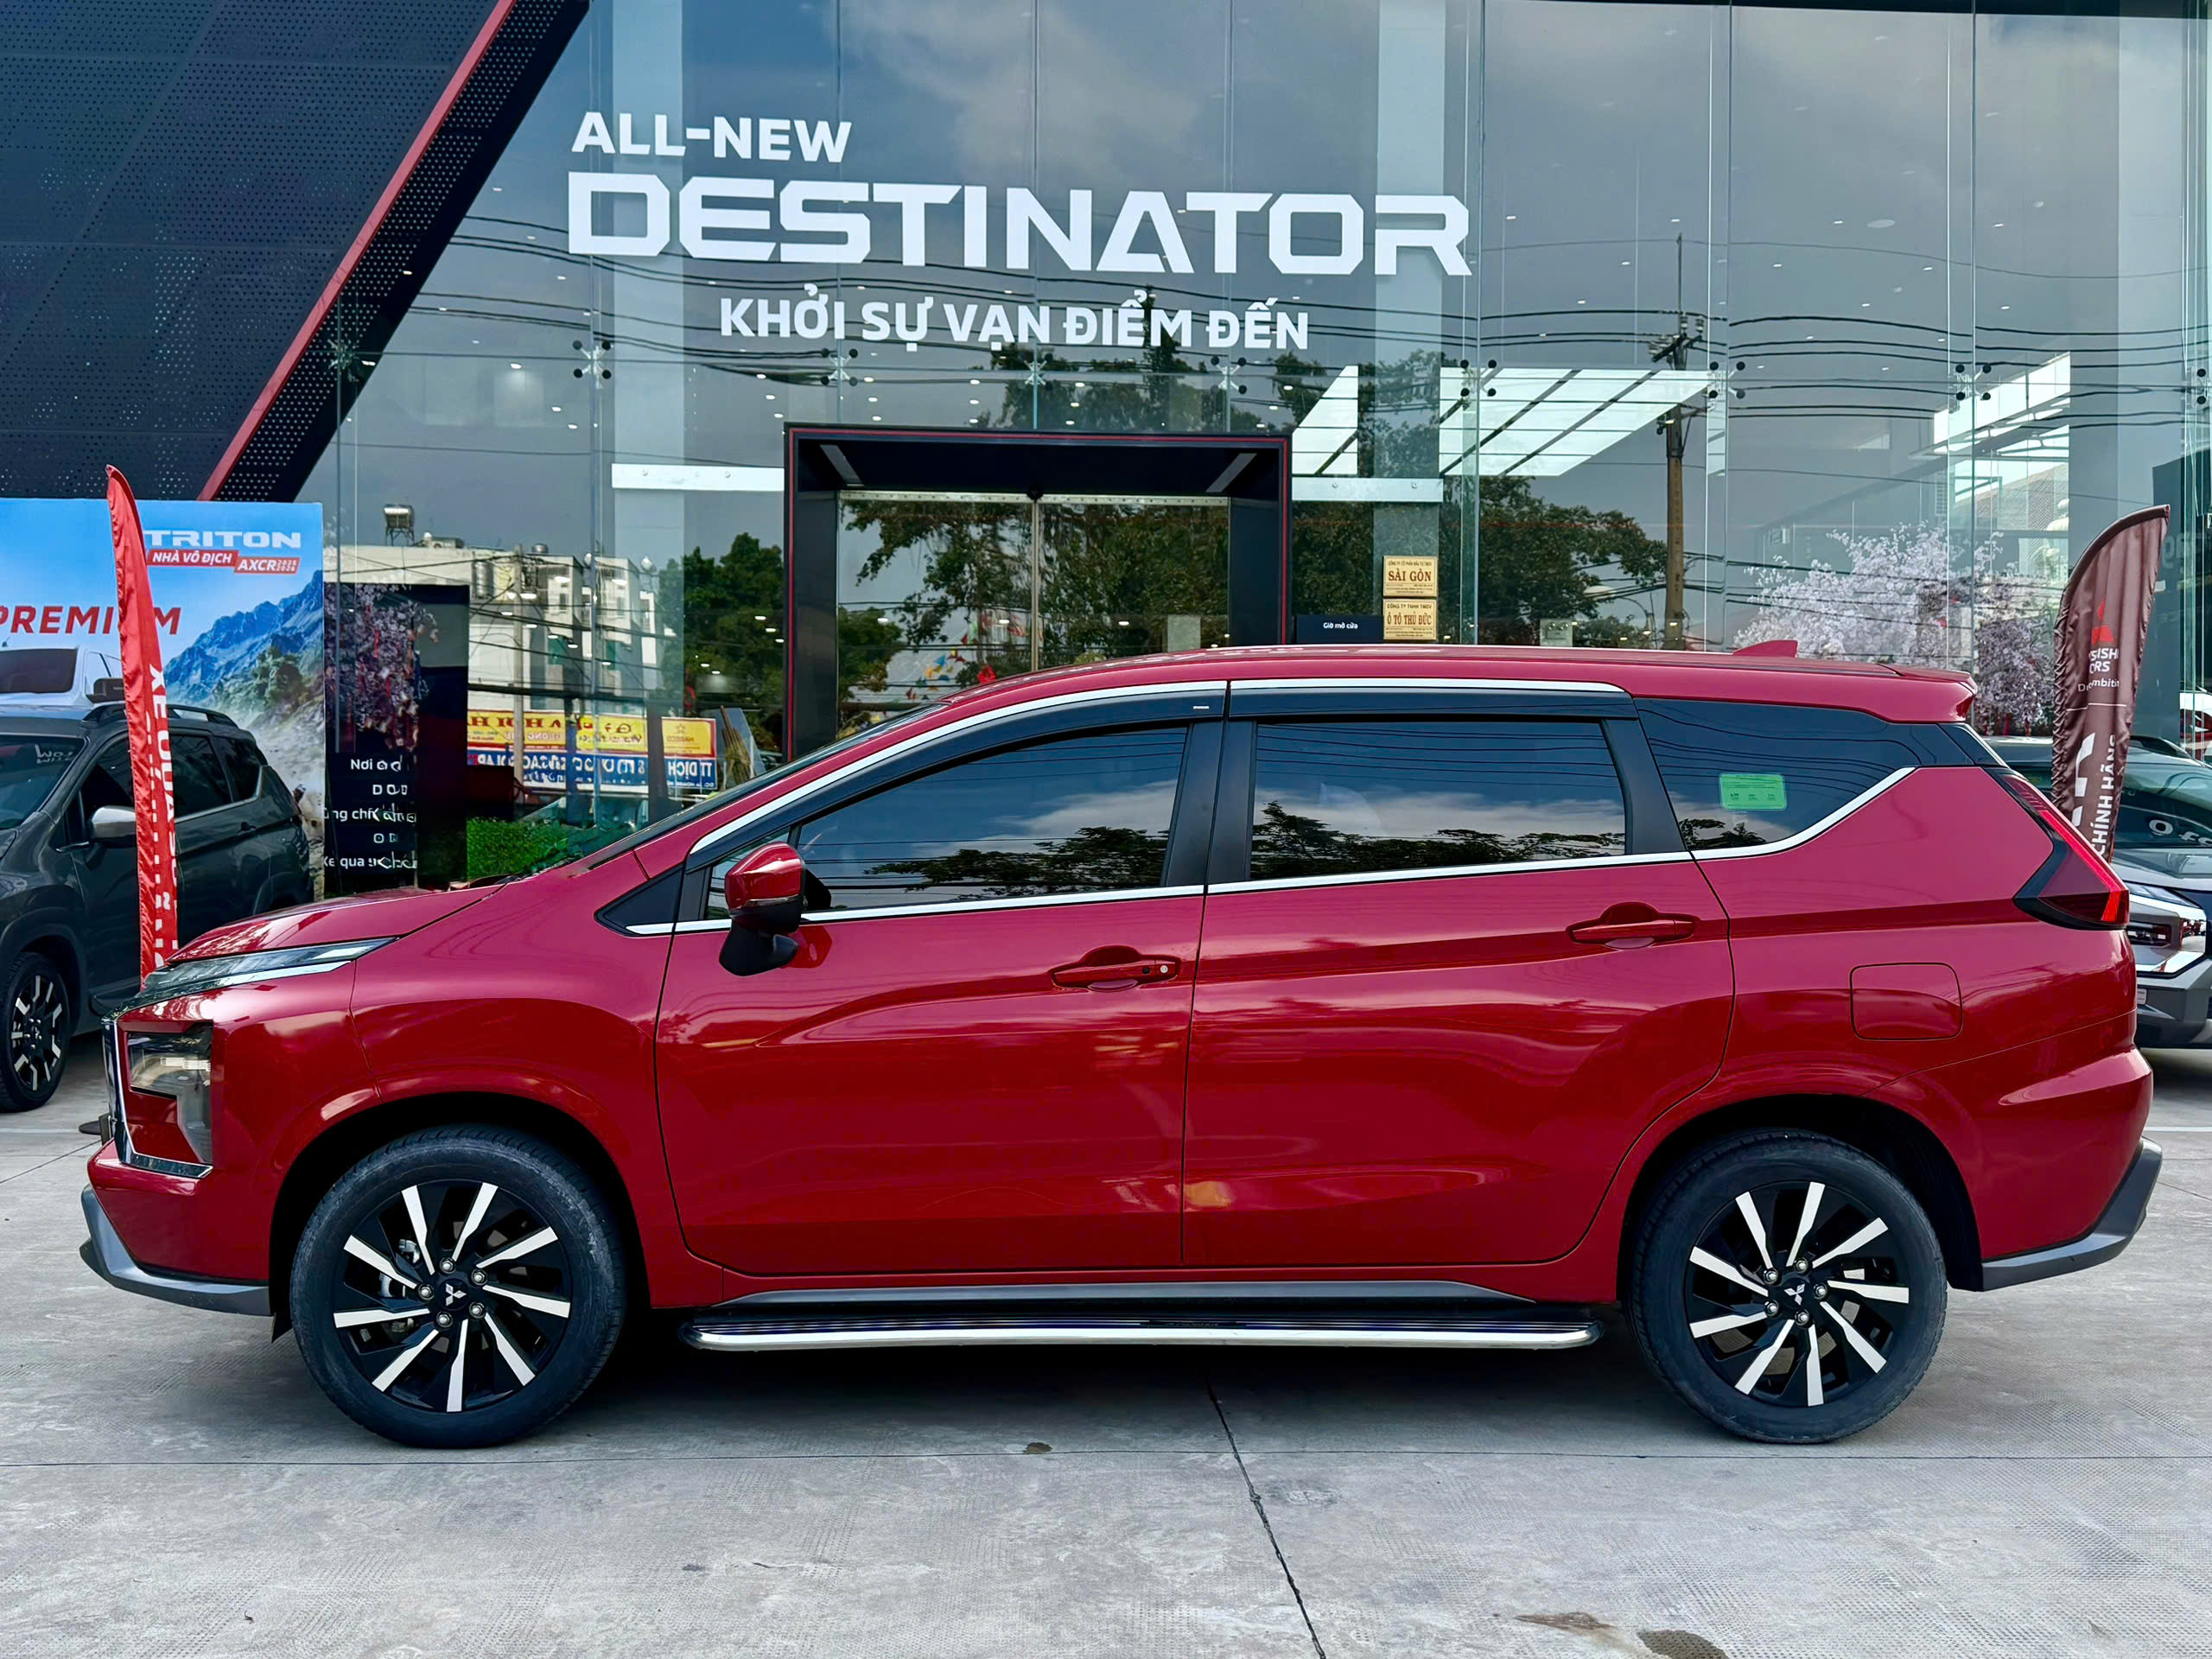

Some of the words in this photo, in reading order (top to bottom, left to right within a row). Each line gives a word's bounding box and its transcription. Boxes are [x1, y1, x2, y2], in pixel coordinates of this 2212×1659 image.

[571, 111, 852, 162] ALL-NEW
[568, 171, 1472, 276] DESTINATOR
[720, 283, 845, 340] KHỞI
[861, 296, 934, 351] SỰ
[944, 303, 1050, 352] VẠN
[1063, 289, 1192, 346] ĐIỂM
[1206, 297, 1309, 350] ĐẾN
[143, 530, 301, 548] TRITON
[152, 550, 180, 563] NHÀ
[182, 550, 200, 563] VÔ
[201, 553, 232, 566] ĐỊCH
[237, 559, 276, 571] AXCR
[1389, 569, 1406, 582] SÀI
[1409, 569, 1431, 582] GÒN
[0, 605, 181, 635] REMIM
[340, 857, 365, 870] qua
